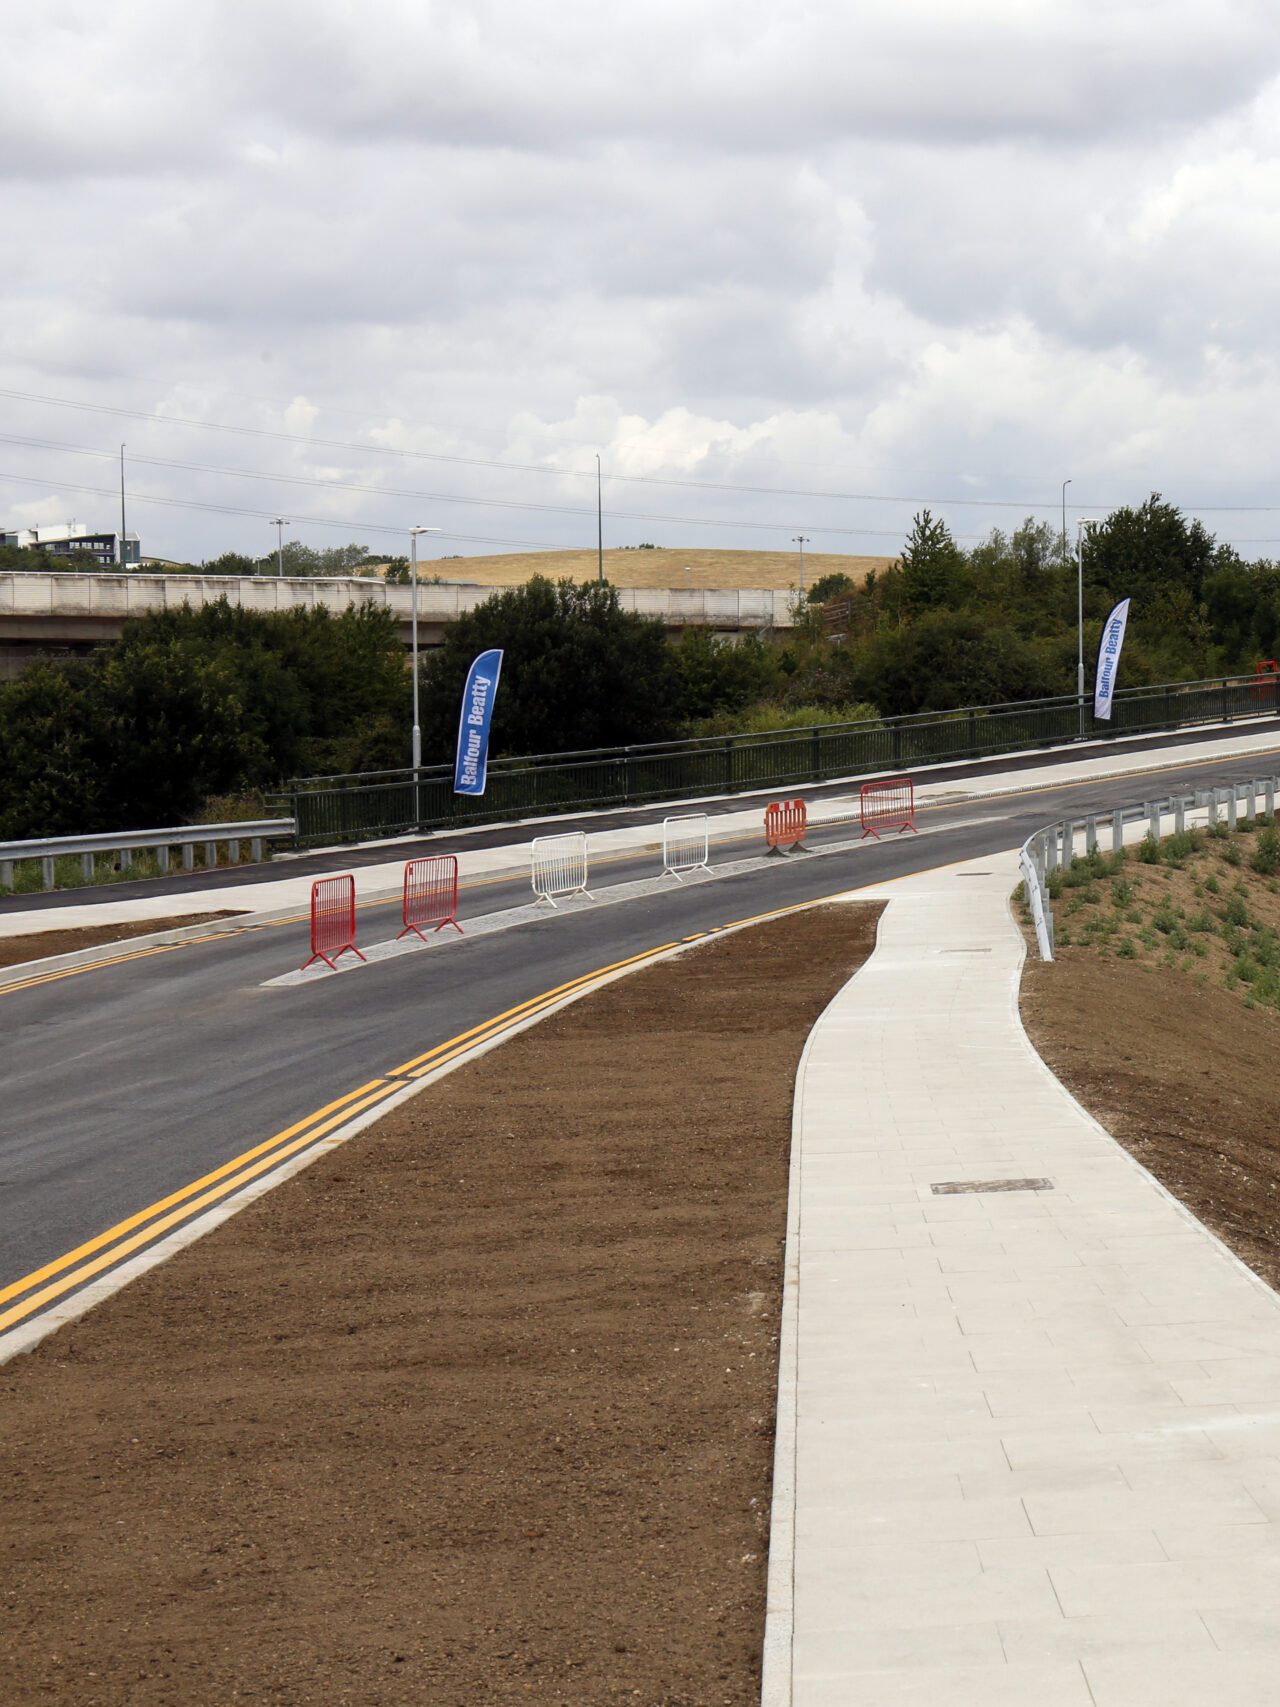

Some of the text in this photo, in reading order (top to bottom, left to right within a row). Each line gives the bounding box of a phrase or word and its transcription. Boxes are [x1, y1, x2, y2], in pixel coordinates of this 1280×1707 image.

[1098, 618, 1123, 698] Balfour Beatty
[460, 675, 491, 785] Balfour Beatty
